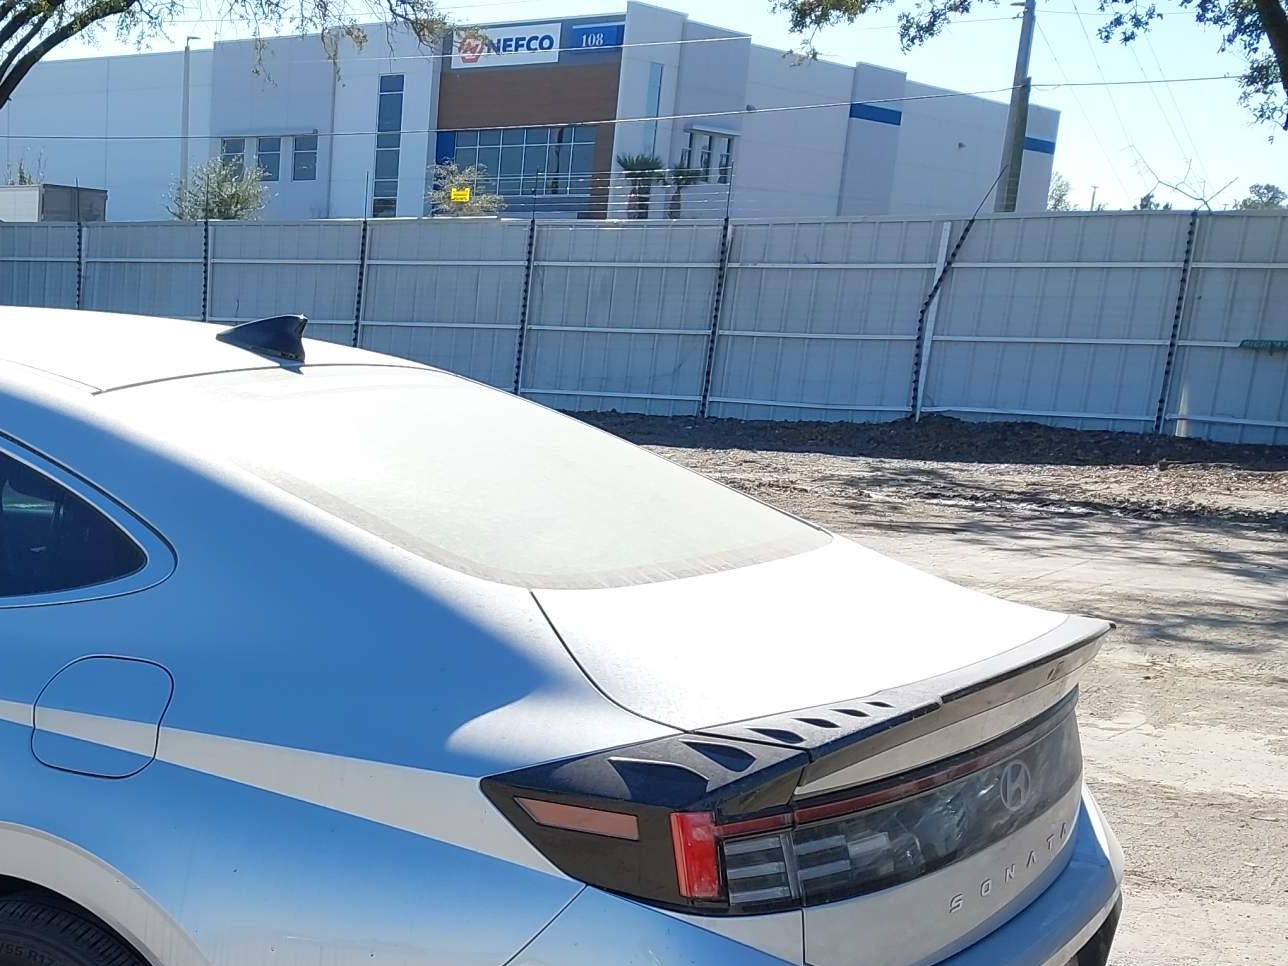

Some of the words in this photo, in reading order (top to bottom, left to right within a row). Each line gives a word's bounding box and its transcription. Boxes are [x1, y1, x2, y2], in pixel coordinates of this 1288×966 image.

[487, 34, 555, 55] NEFCO
[582, 32, 604, 48] 108
[948, 821, 1068, 914] SONATA
